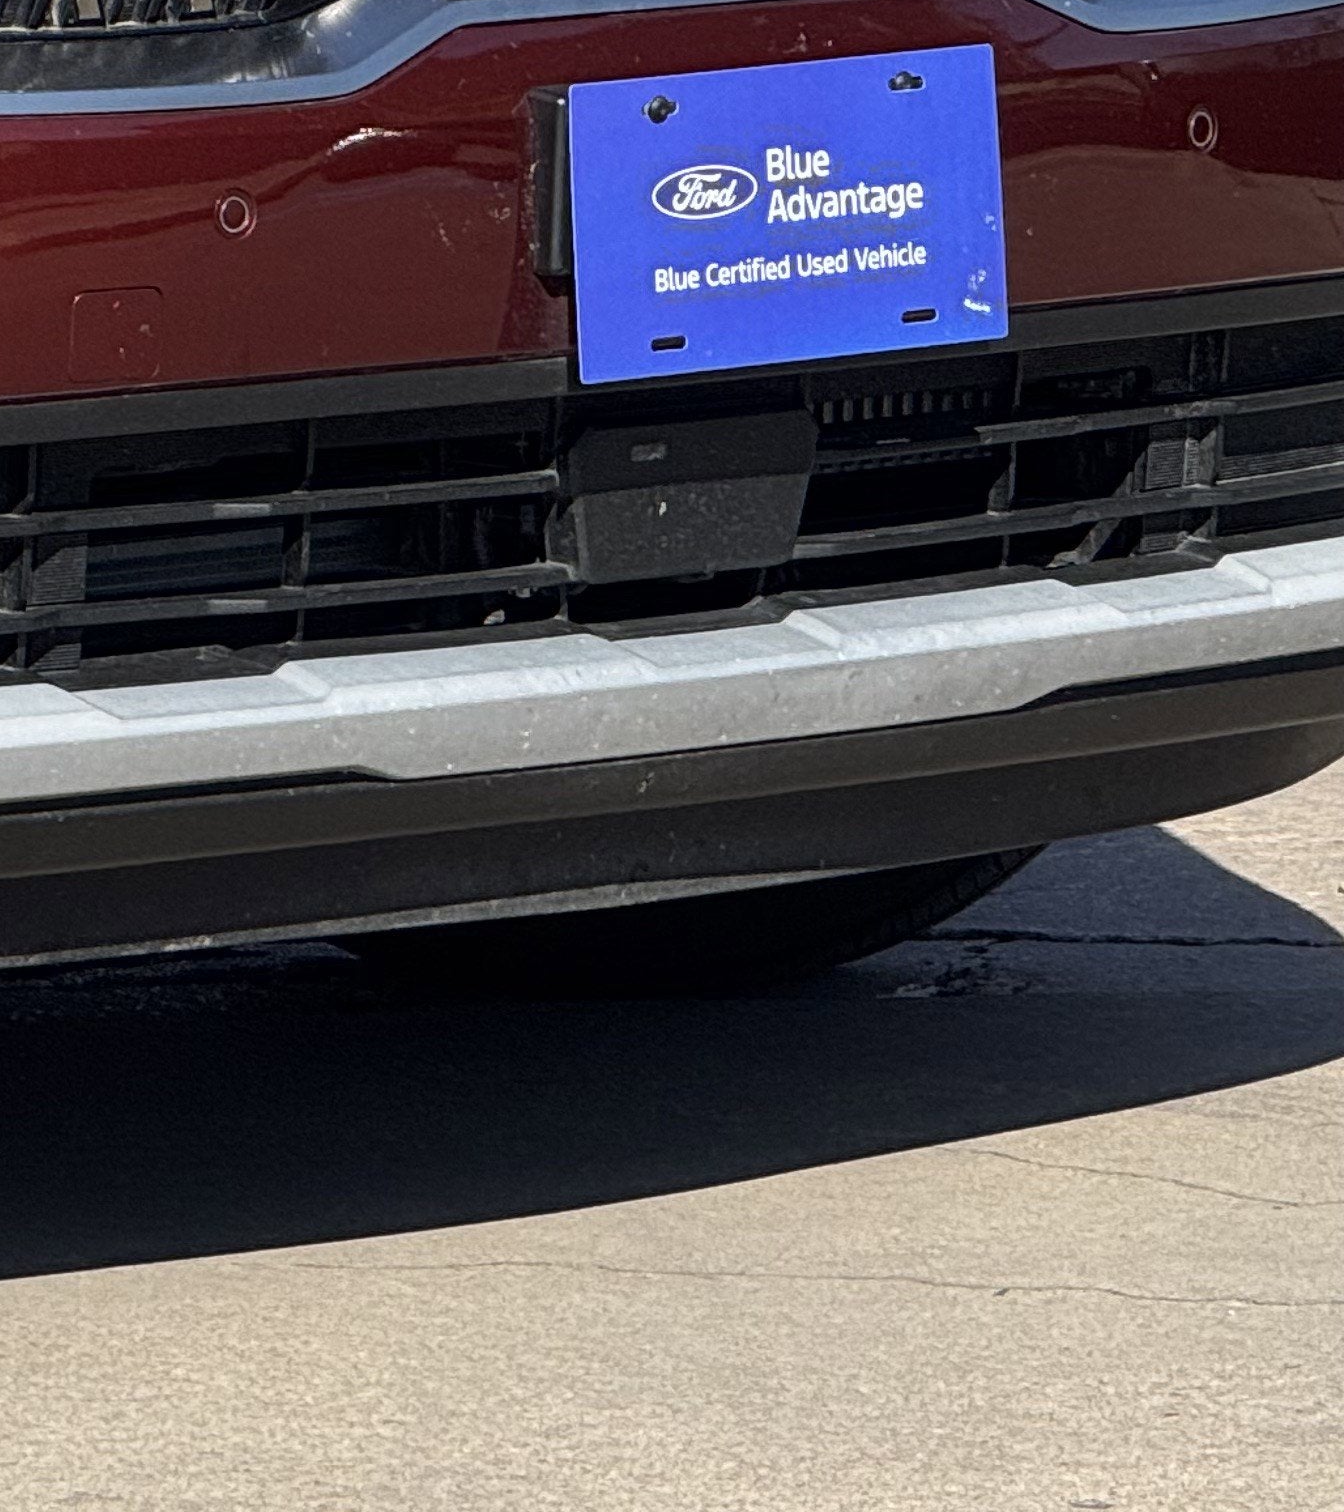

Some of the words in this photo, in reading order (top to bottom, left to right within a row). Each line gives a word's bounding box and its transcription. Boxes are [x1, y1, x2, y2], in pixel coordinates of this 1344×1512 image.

[765, 144, 830, 182] Blue
[672, 172, 738, 212] Ford
[767, 181, 924, 224] Advantage
[654, 266, 700, 293] Blue
[705, 254, 791, 286] Certified
[796, 247, 849, 277] Used
[853, 241, 927, 272] Vehicle
